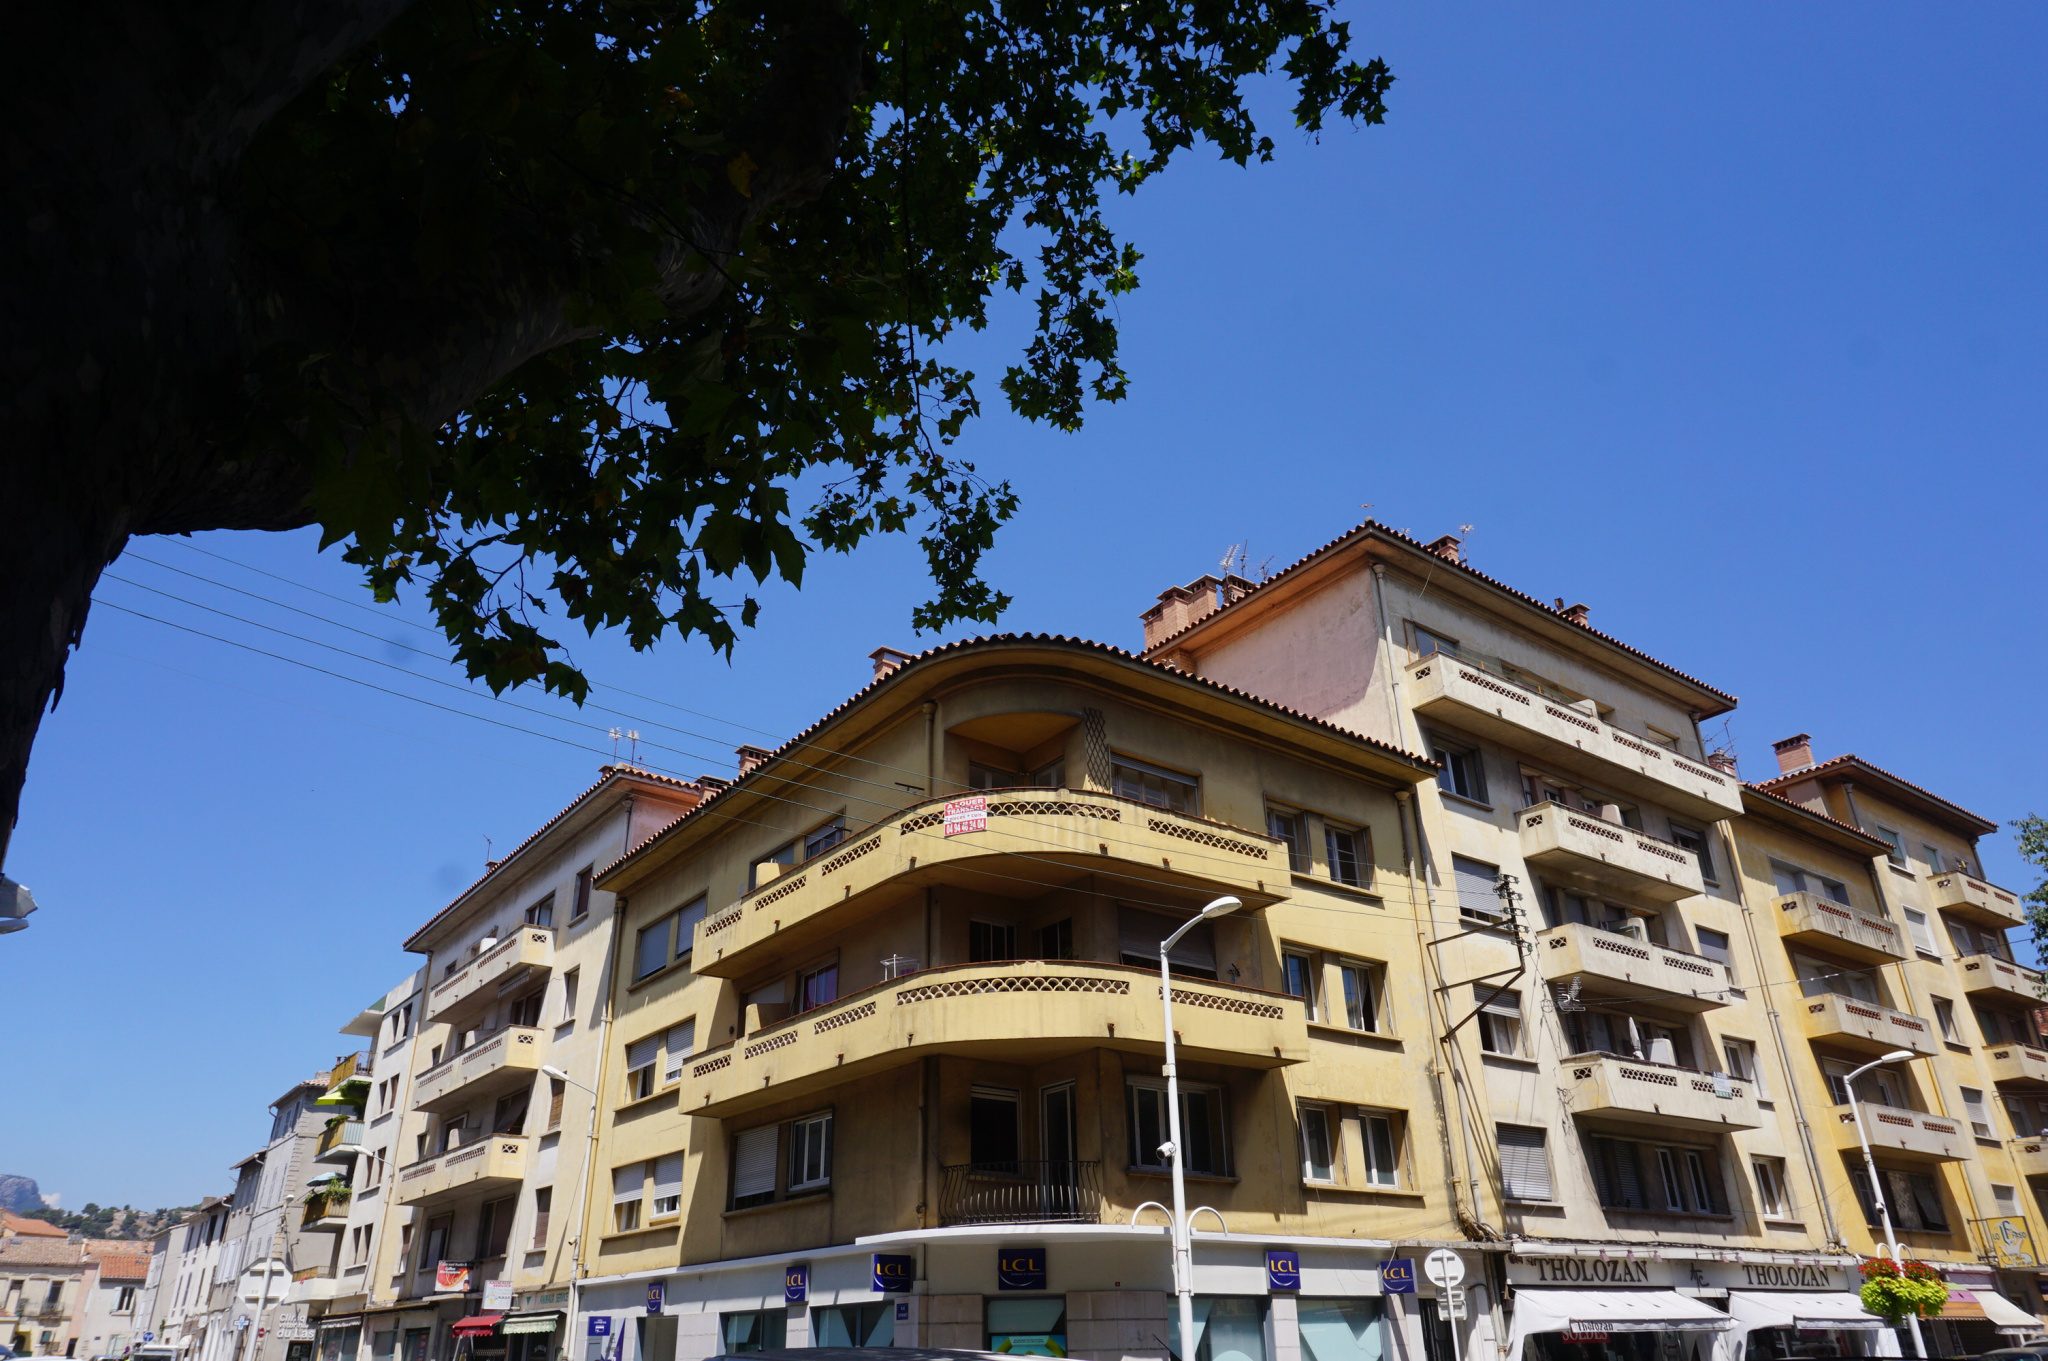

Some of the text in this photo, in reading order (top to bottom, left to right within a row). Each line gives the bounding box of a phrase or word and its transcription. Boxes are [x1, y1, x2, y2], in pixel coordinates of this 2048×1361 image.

[955, 799, 984, 807] LOUER
[947, 804, 985, 814] TRANSACT
[877, 1263, 907, 1275] LCL
[1002, 1258, 1040, 1271] LCL
[1271, 1260, 1297, 1272] LCL
[1536, 1257, 1648, 1282] THOLOZAN
[1383, 1268, 1410, 1279] LCL
[1742, 1265, 1830, 1287] THOLOZAN
[786, 1274, 804, 1286] LCL
[648, 1289, 660, 1299] LCL
[1577, 1321, 1614, 1331] Tholozan
[277, 1328, 315, 1339] du Las
